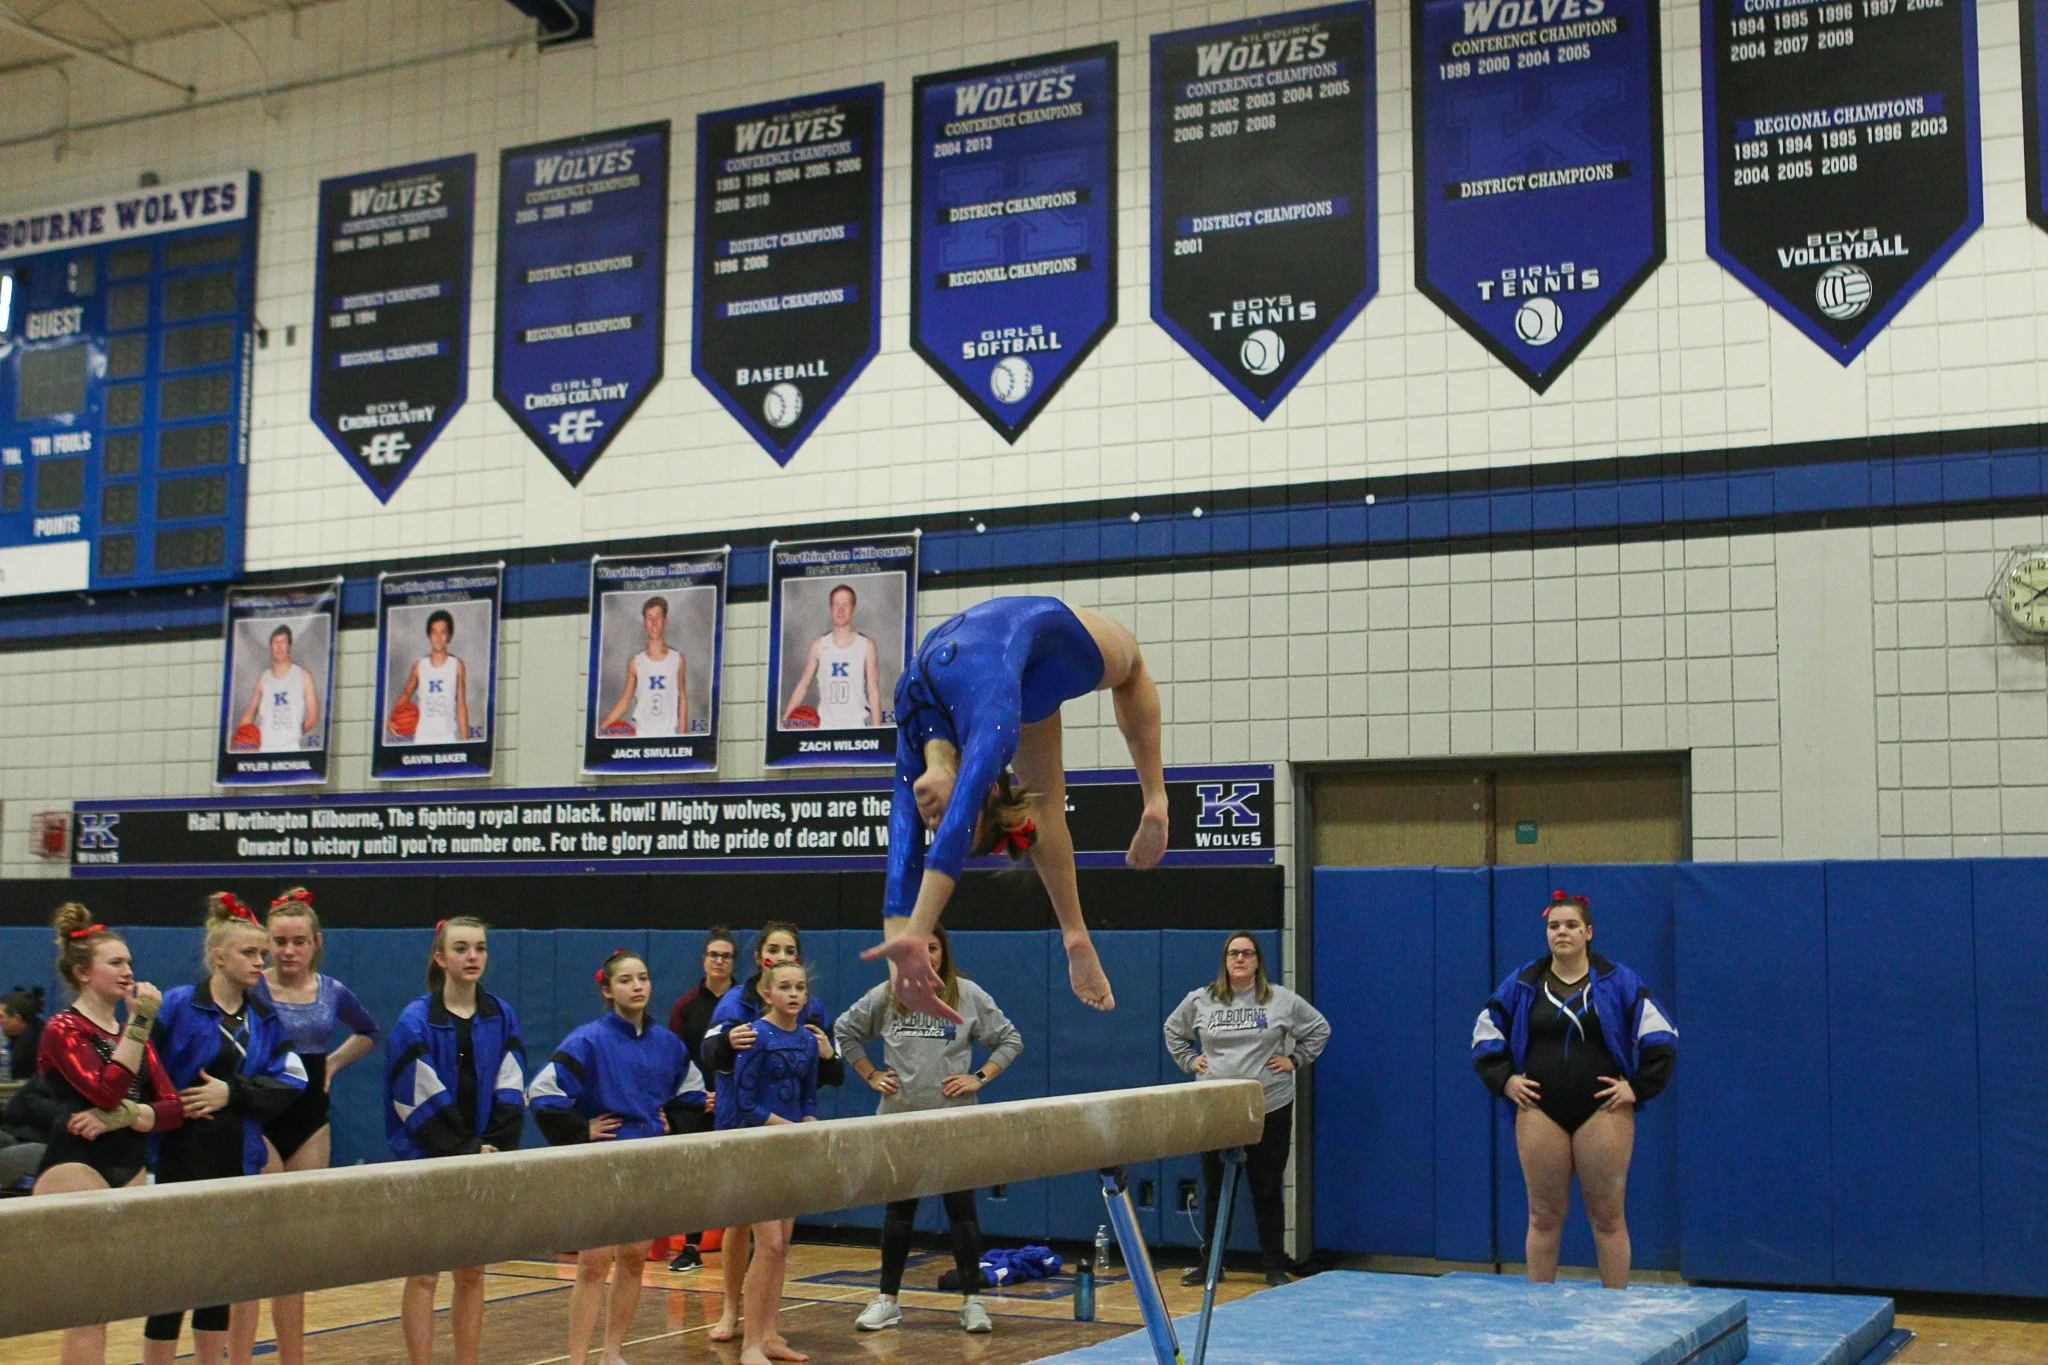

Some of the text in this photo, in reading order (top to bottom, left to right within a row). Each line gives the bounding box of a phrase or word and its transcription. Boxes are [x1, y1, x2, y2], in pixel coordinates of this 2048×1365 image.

[1463, 0, 1605, 35] WOLVES
[1731, 16, 1765, 37] 1994
[1775, 9, 1808, 31] 1995
[1863, 0, 1897, 18] 1997
[1452, 17, 1617, 57] CONFERENCE CHAMPIONS
[1731, 33, 1808, 62] 2004 2007
[1197, 32, 1329, 77] WOLVES
[1440, 43, 1591, 80] 1999 2000 2004 2005
[1186, 61, 1338, 98] CONFERENCE CHAMPIONS
[955, 74, 1076, 117] WOLVES
[1210, 97, 1239, 115] 2002
[1246, 92, 1276, 110] 2003
[1282, 86, 1313, 104] 2004
[1319, 80, 1350, 99] 2005
[945, 102, 1083, 136] CONFERENCE CHAMPIONS
[1209, 120, 1239, 138] 2007
[1754, 97, 1924, 136] REGIONAL CHAMPIONS
[735, 113, 846, 153] WOLVES
[933, 136, 993, 159] 2004 2013
[1734, 140, 1768, 161] 1993
[1778, 134, 1813, 155] 1994
[1822, 127, 1857, 150] 1995
[1911, 116, 1948, 139] 2003
[534, 148, 636, 186] WOLVES
[726, 140, 852, 172] CONFERENCE CHAMPIONS
[1734, 153, 1858, 186] 2004 2005 2008
[1461, 164, 1614, 198] DISTRICT CHAMPIONS
[351, 181, 444, 217] WOLVES
[950, 191, 1077, 222] DISTRICT CHAMPIONS
[0, 183, 237, 249] BOURNE WOLVES
[1192, 200, 1333, 233] DISTRICT CHAMPIONS
[729, 225, 845, 254] DISTRICT CHAMPIONS
[1174, 238, 1203, 256] 2001
[1777, 234, 1909, 268] VOLLEYBALL
[1807, 227, 1878, 247] BOYS
[527, 255, 633, 283] DISTRICT CHAMPIONS
[949, 258, 1077, 287] REGIONAL CHAMPIONS
[1502, 262, 1575, 280] GIRLS
[1477, 269, 1600, 301] TENNIS
[727, 288, 844, 317] REGIONAL CHAMPIONS
[1209, 301, 1317, 331] TENNIS
[1233, 294, 1292, 312] BOYS
[26, 307, 84, 341] GUEST
[526, 316, 632, 343] REGIONAL CHAMPIONS
[981, 325, 1043, 341] GIRLS
[962, 332, 1062, 360] SOFTBALL
[551, 377, 602, 392] GIRLS
[736, 359, 829, 386] BASEBALL
[525, 383, 629, 410] CROSS COUNTRY
[380, 405, 436, 426] COUNTRY
[52, 431, 92, 454] FOULS
[33, 515, 81, 538] POINTS
[776, 546, 913, 564] Worthington Kilbourne
[649, 675, 666, 689] K
[831, 662, 849, 677] K
[274, 692, 288, 705] K
[428, 680, 444, 693] K
[470, 726, 482, 737] K
[692, 720, 705, 731] K
[402, 753, 467, 765] GAVIN BAKER
[612, 747, 693, 758] JACK SMULLEN
[799, 740, 879, 752] ZACH WILSON
[224, 811, 308, 833] Worthington
[311, 809, 384, 830] Kilbourne,
[388, 808, 415, 828] The
[418, 808, 475, 829] fighting
[479, 806, 518, 828] royal
[522, 805, 551, 823] and
[557, 804, 605, 823] black.
[610, 802, 655, 822] Howl!
[661, 801, 718, 824] Mighty
[723, 800, 786, 822] wolves,
[791, 801, 821, 822] you
[827, 799, 856, 817] are
[863, 796, 890, 816] the
[1197, 784, 1260, 828] K
[79, 814, 120, 848] K
[237, 837, 290, 857] Onward
[293, 838, 308, 856] to
[312, 836, 360, 858] victory
[364, 835, 397, 854] until
[401, 834, 447, 858] you're
[452, 834, 508, 853] number
[512, 836, 546, 853] one.
[551, 832, 575, 851] For
[581, 832, 607, 851] the
[612, 832, 651, 855] glory
[657, 831, 688, 850] and
[693, 830, 720, 849] the
[725, 829, 769, 853] pride
[774, 828, 792, 848] of
[797, 827, 836, 848] dear
[842, 827, 870, 847] old
[1196, 832, 1261, 848] WOLVES
